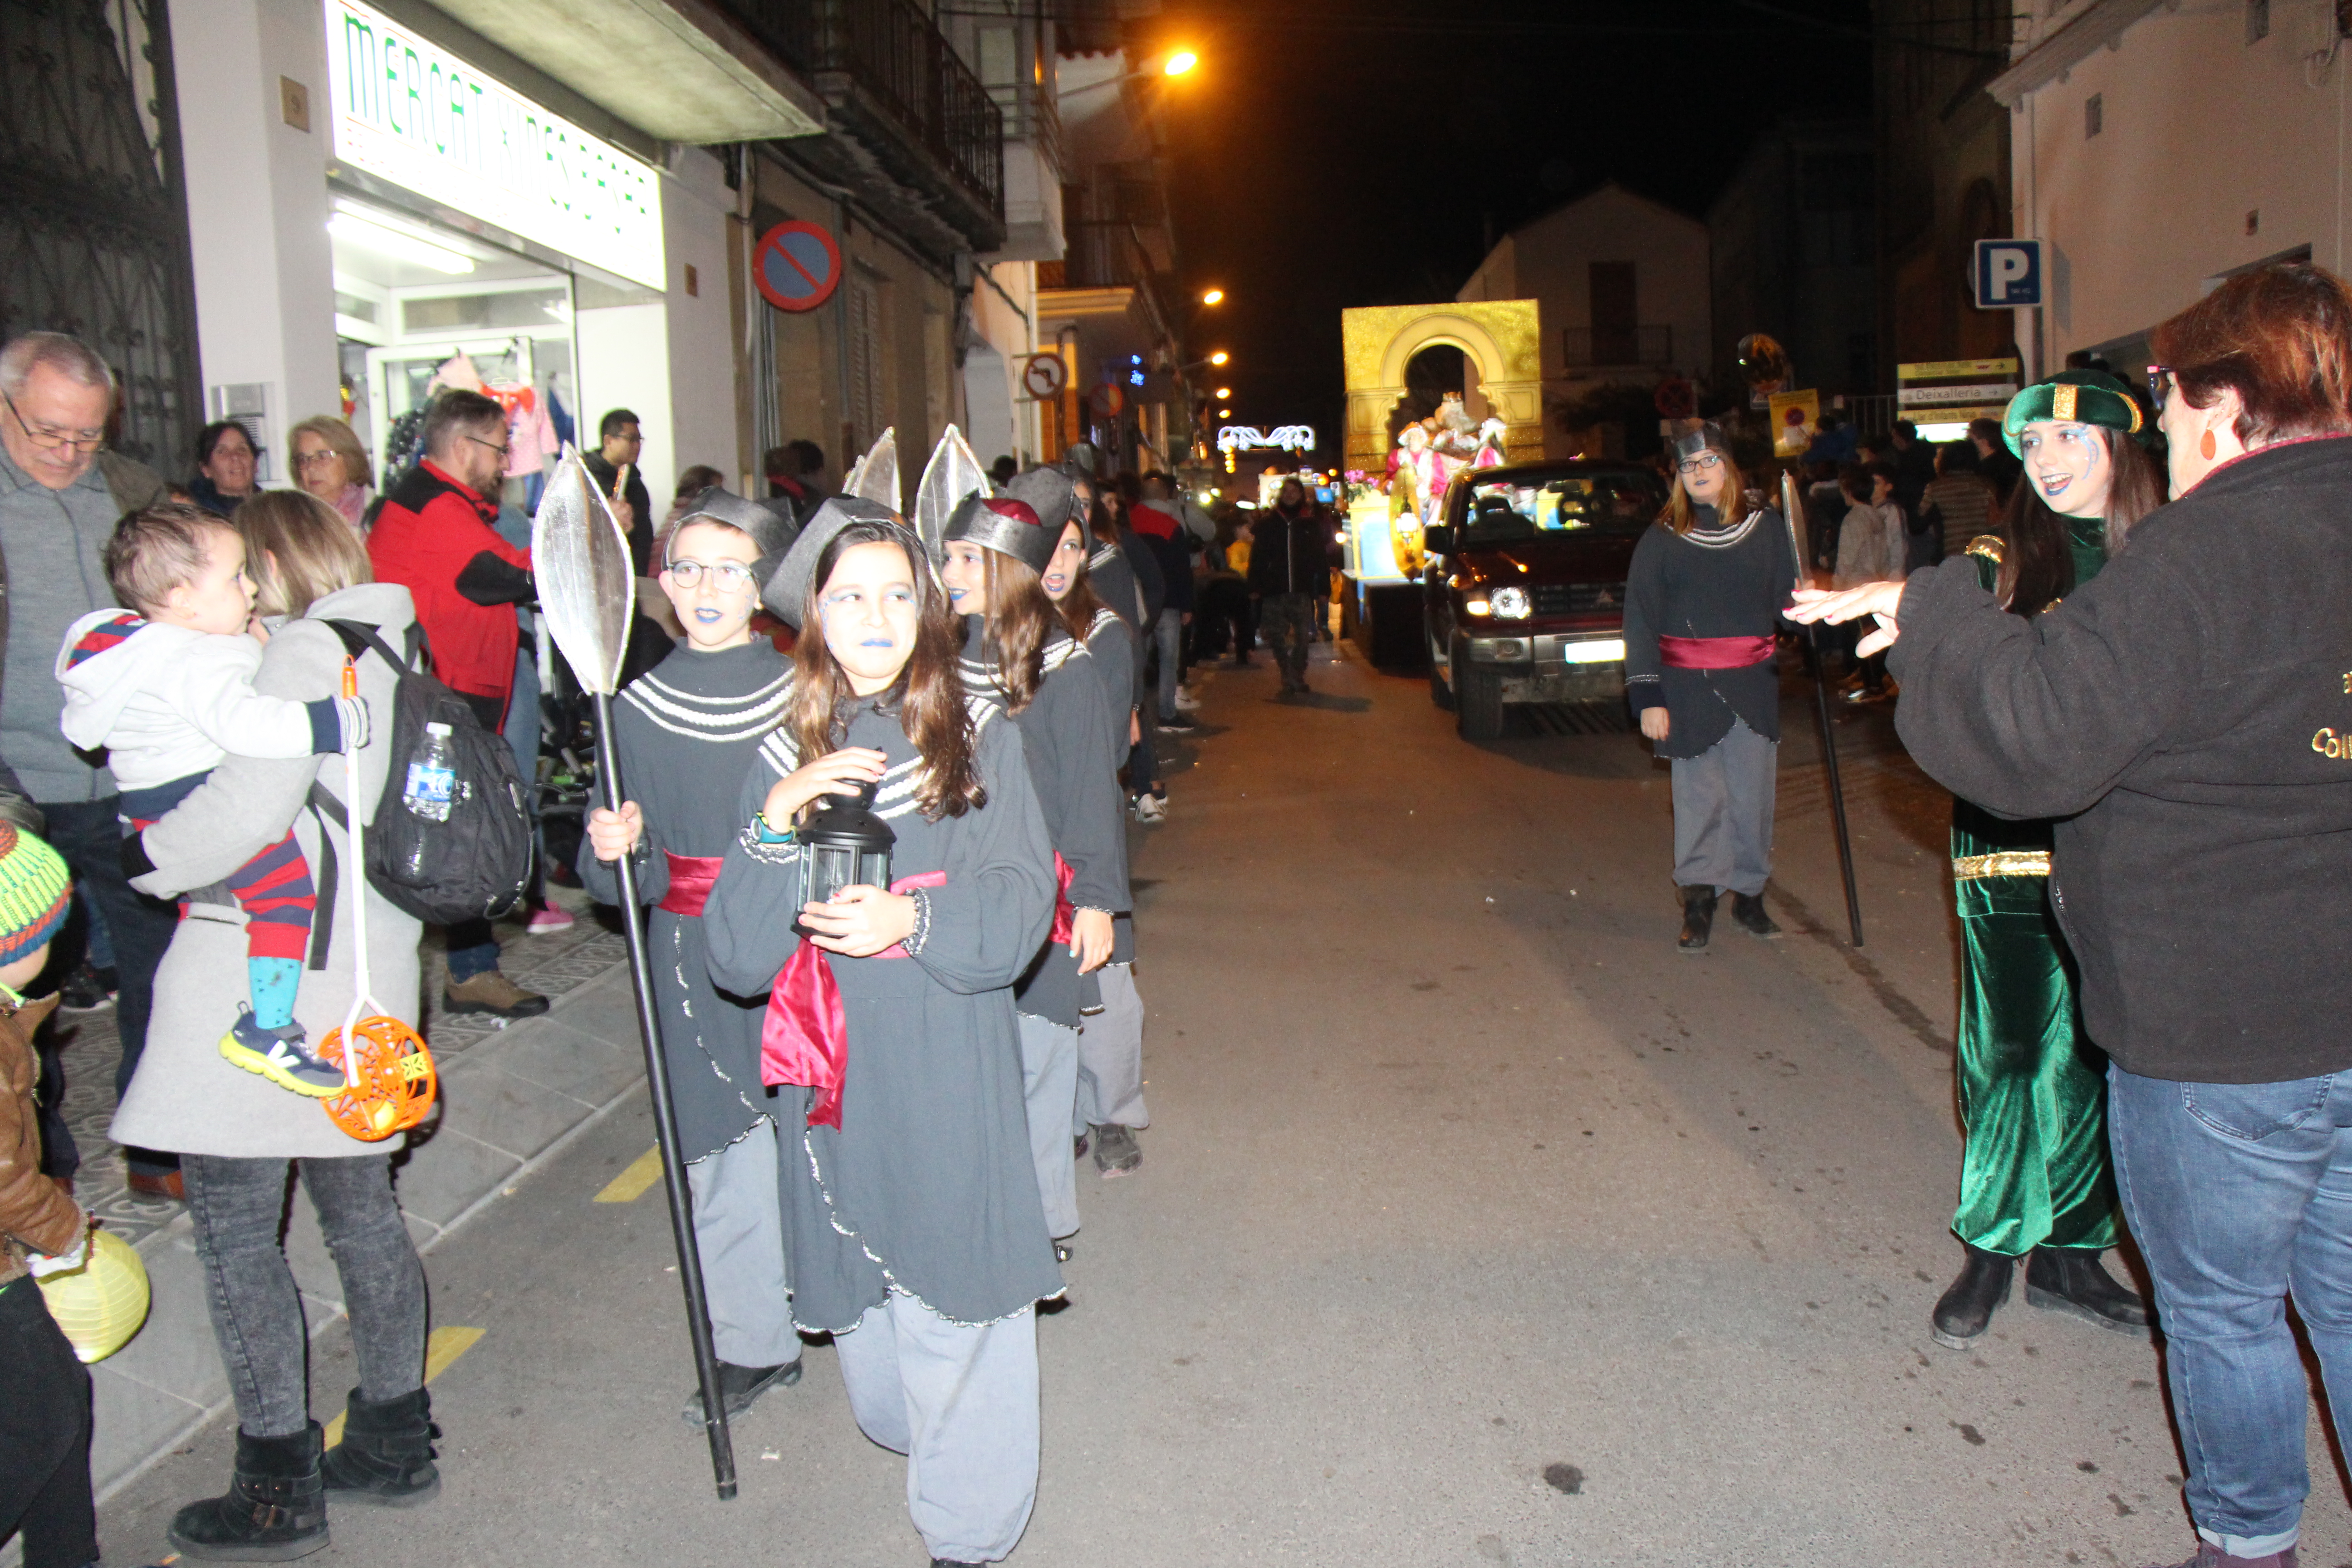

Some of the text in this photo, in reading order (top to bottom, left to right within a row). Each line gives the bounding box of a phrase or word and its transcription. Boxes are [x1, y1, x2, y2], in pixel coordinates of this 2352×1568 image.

[343, 11, 484, 172] MERCAT
[1990, 248, 2030, 300] P
[1916, 387, 1981, 400] Deixalleria
